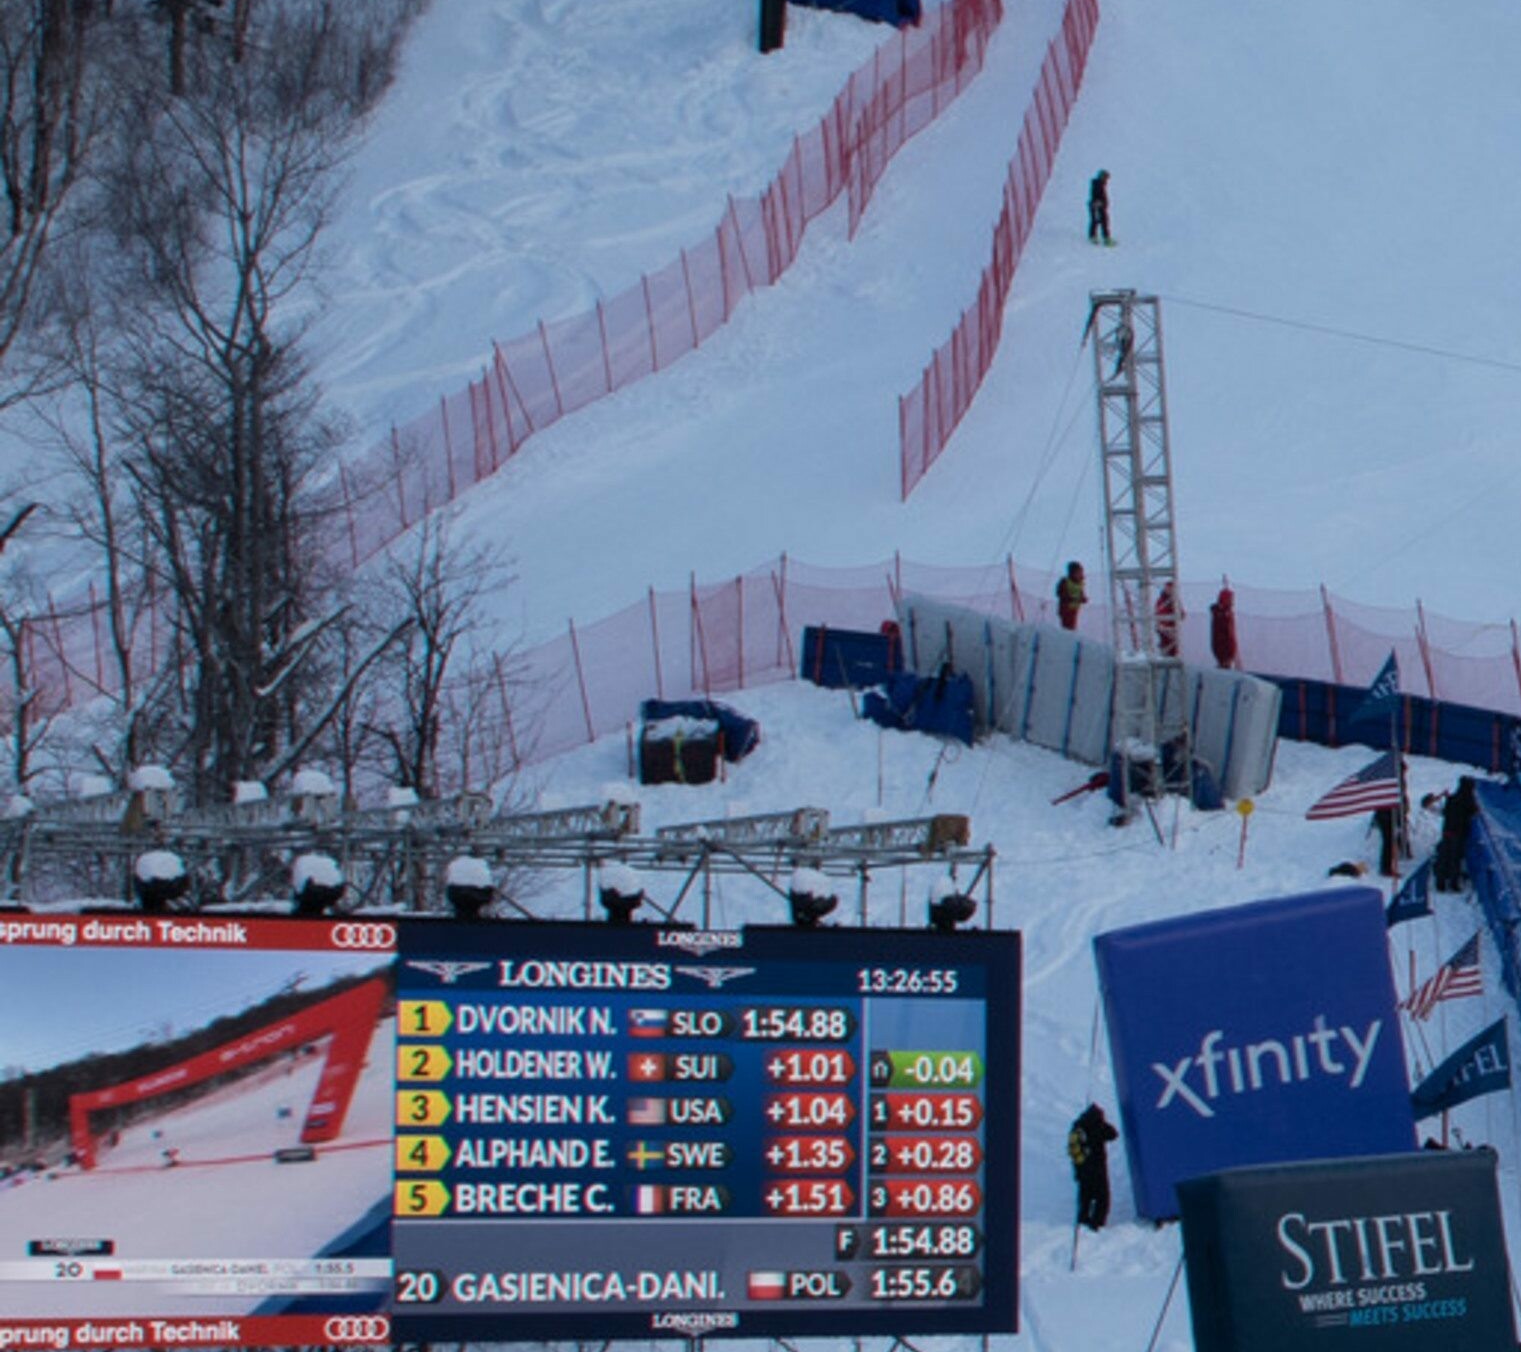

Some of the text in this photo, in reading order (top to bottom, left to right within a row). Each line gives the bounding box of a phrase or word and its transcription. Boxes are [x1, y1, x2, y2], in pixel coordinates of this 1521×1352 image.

[83, 920, 150, 941] durch
[157, 921, 248, 943] Technik
[658, 931, 742, 948] LONGINES
[499, 959, 672, 990] LONGINES
[857, 968, 959, 993] 13:26:55
[414, 1005, 848, 1039] 1 DVORNIK N. SLO 1:54.88
[411, 1049, 847, 1081] 2 HOLDENER W. SUI +1.01
[904, 1056, 975, 1083] -0.04
[1152, 1014, 1382, 1117] xfinity
[411, 1094, 847, 1124] 3 HENSIEN K. USA +1.04
[874, 1099, 974, 1126] 1 +0.15
[409, 1138, 846, 1168] 4 ALPHAND E. SWE +1.35
[872, 1141, 974, 1169] 2 +0.28
[410, 1184, 845, 1213] 5 BRECHE C. FRA +1.51
[872, 1185, 974, 1212] 3 +0.86
[838, 1226, 975, 1255] F 1:54.88
[1276, 1210, 1475, 1290] STIFEL
[55, 1262, 84, 1277] 20
[398, 1272, 439, 1303] 20
[452, 1270, 726, 1302] GASIENICA-DANI.
[791, 1272, 841, 1297] POL
[1300, 1281, 1428, 1312] WHERE SUCCESS
[653, 1313, 740, 1329] LONGINES
[1350, 1297, 1467, 1327] MEETS SUCCESS
[76, 1321, 144, 1342] durch
[150, 1320, 240, 1342] Technik
